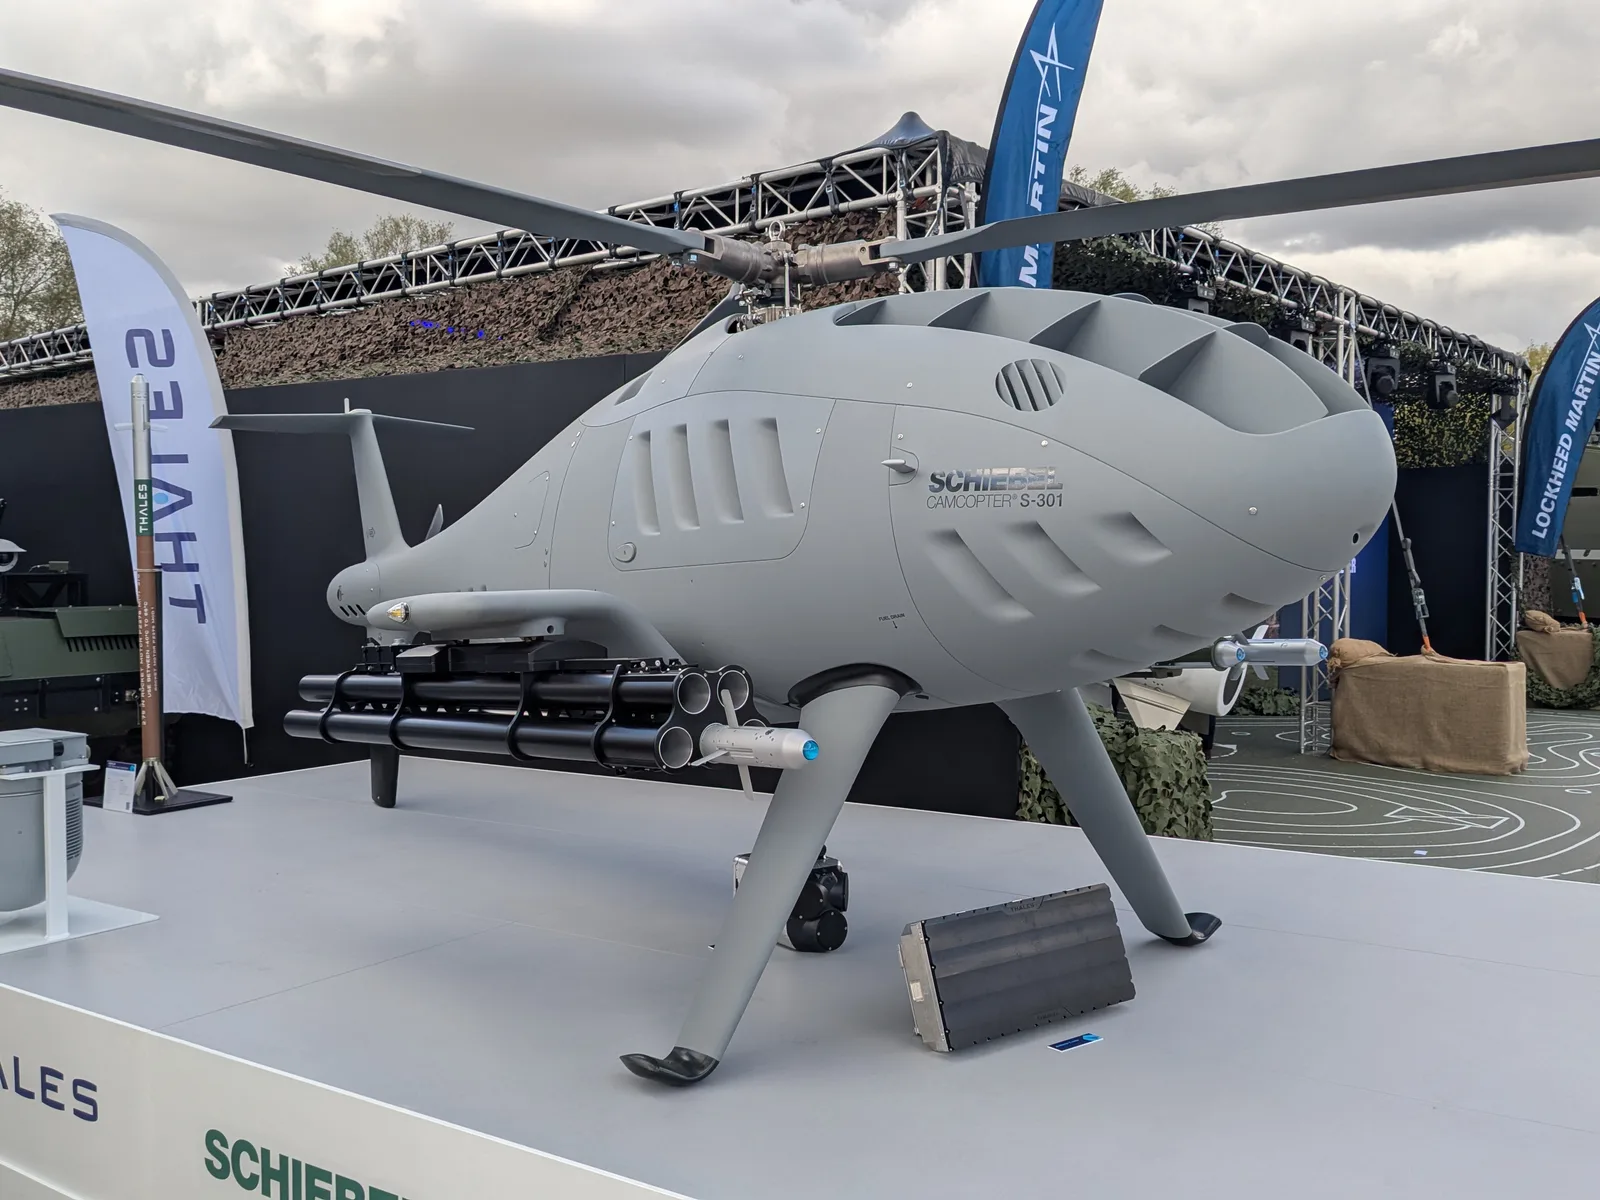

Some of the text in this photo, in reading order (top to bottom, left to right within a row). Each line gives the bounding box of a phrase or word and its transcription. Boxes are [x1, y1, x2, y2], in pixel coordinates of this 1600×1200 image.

[1019, 104, 1058, 287] MRTIN
[1532, 351, 1600, 539] LOCKHEED MARTIN
[928, 466, 1063, 493] SCHIEBEL
[1020, 493, 1063, 507] S-301
[138, 483, 148, 533] THALES
